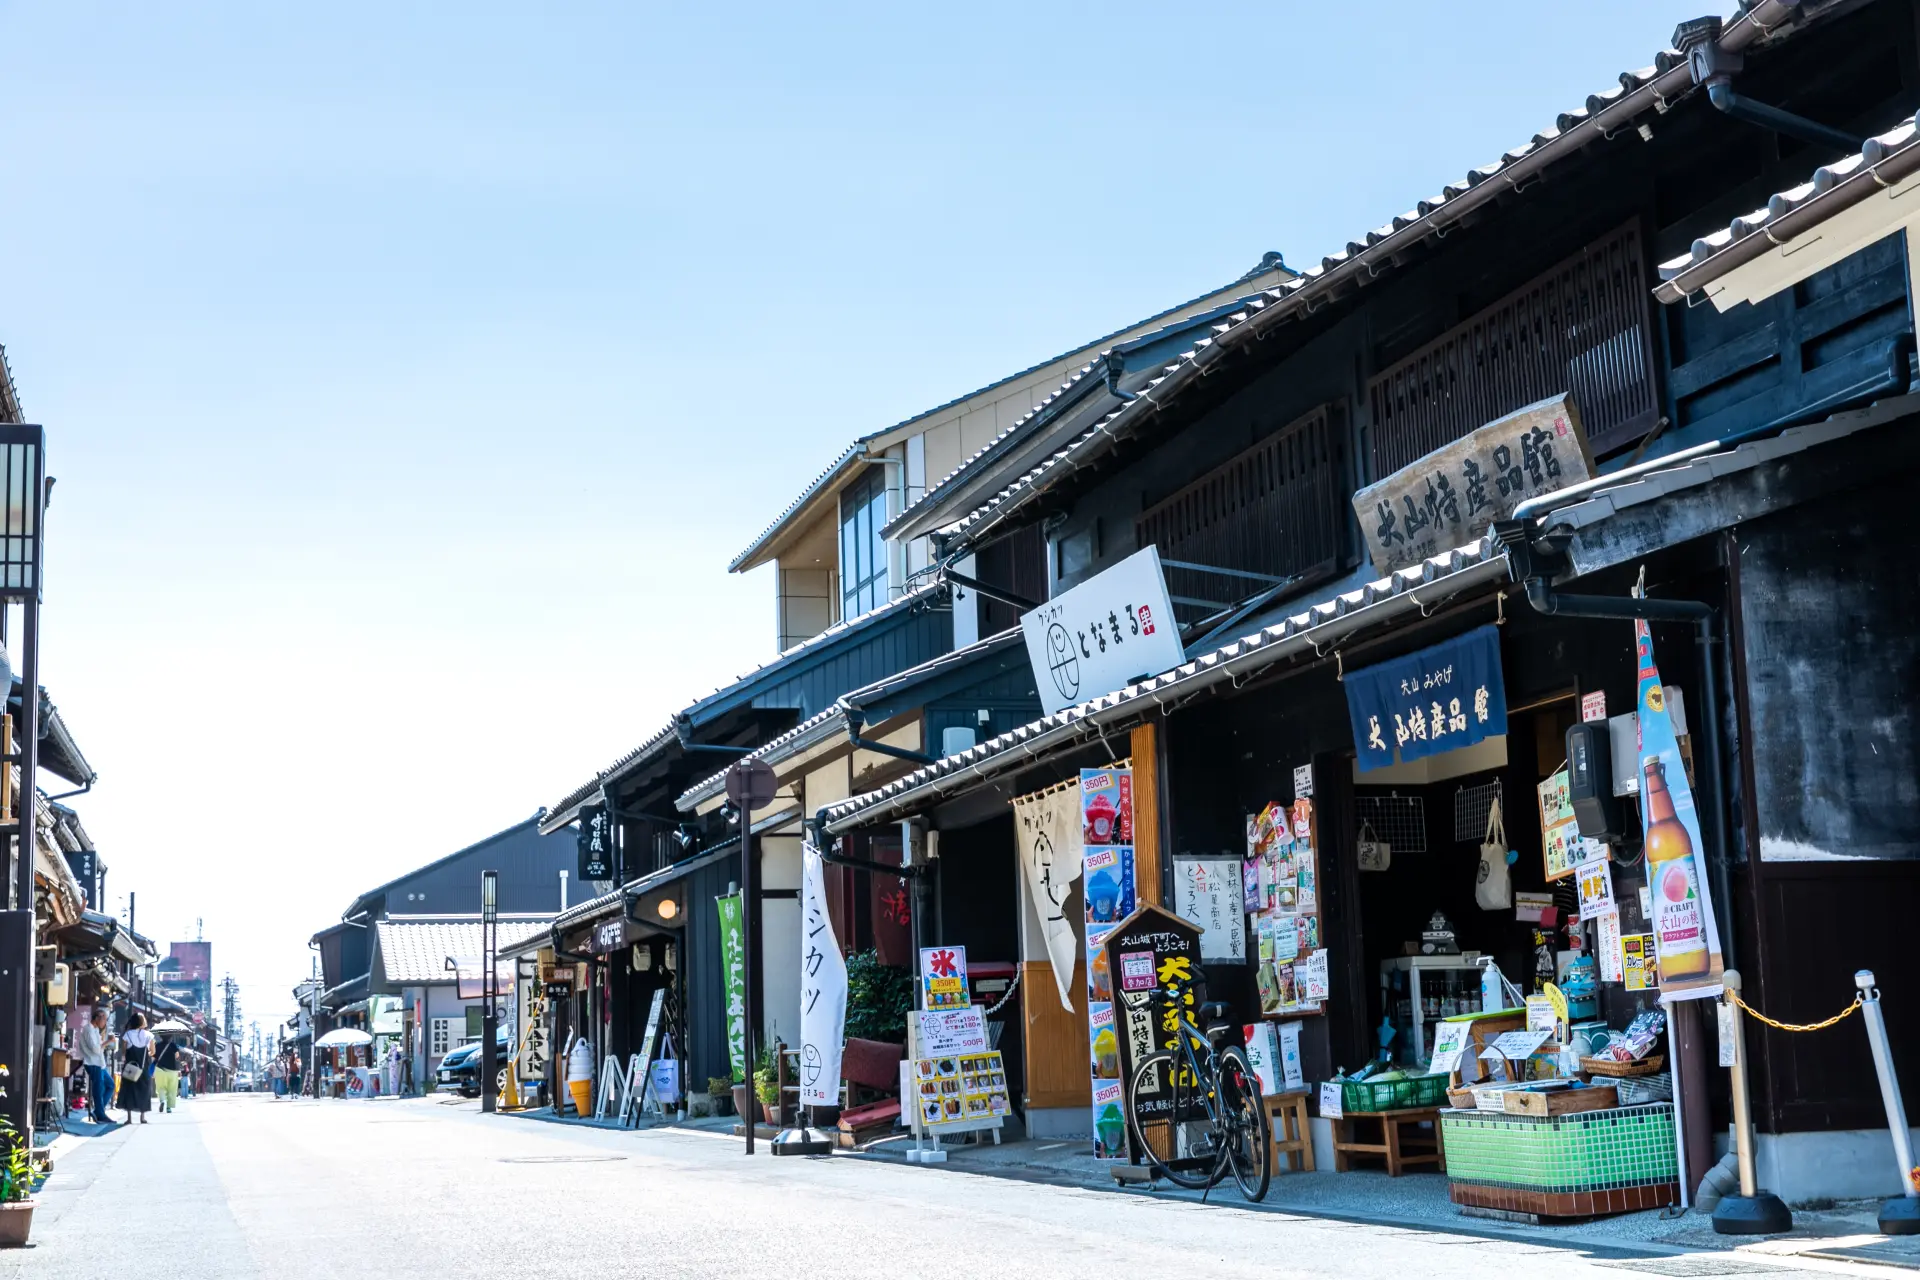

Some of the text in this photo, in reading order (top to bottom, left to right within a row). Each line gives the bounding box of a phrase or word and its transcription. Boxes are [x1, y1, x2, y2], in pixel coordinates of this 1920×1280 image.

[1377, 425, 1561, 547] 犬山特産品館
[1077, 604, 1139, 659] となまる
[1367, 684, 1489, 752] 犬山特産品館
[1084, 774, 1109, 791] 350円
[1121, 776, 1131, 838] かき氷いちご
[1086, 851, 1112, 868] 350円
[1670, 901, 1694, 913] CRAFT
[1660, 910, 1699, 931] 犬山の桃
[1121, 932, 1180, 946] 犬山城下町へ
[1155, 940, 1190, 952] ようこそ!
[930, 949, 957, 977] 氷
[935, 979, 956, 988] 350円
[1127, 976, 1153, 988] 参加店
[962, 1037, 983, 1047] 500円
[1095, 1085, 1120, 1102] 350円
